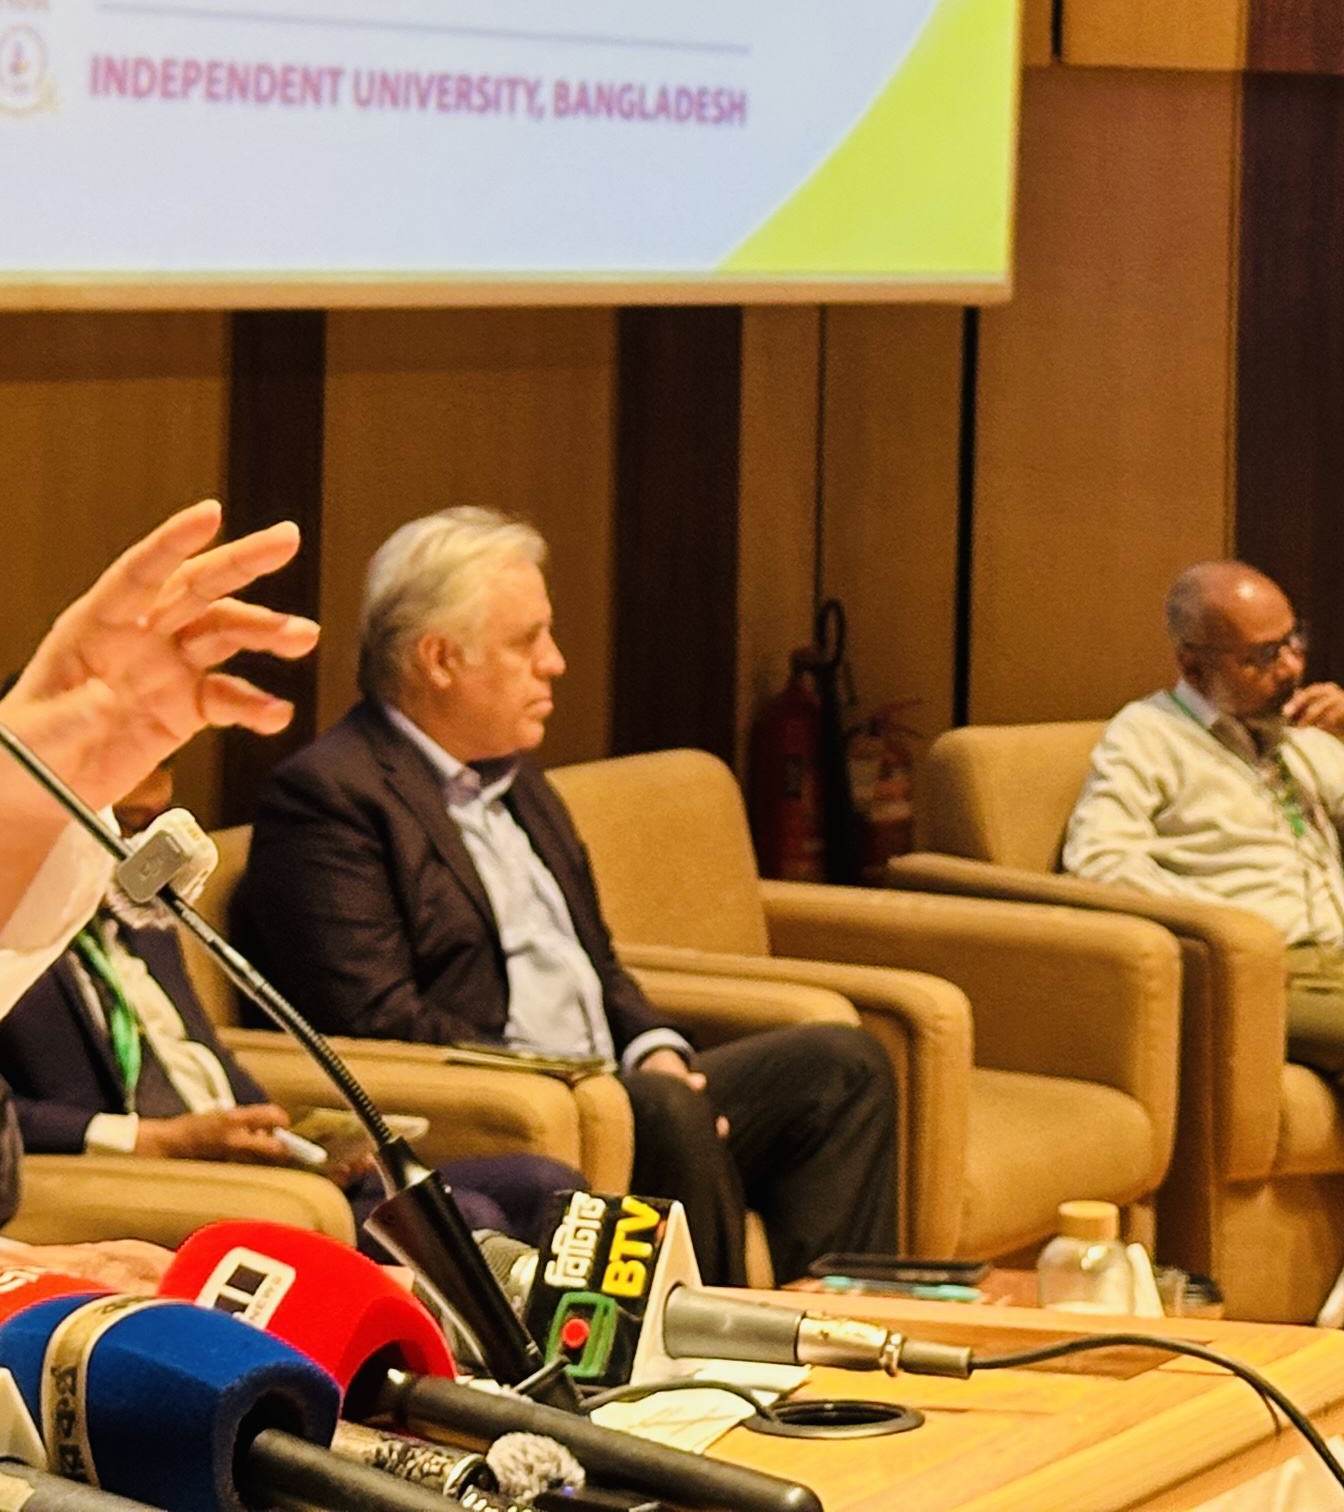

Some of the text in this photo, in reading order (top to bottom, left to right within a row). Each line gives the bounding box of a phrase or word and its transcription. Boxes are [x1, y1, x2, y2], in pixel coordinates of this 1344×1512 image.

[89, 53, 750, 126] INDEPENDENT UNIVERSITY, BANGLADESH
[602, 1195, 661, 1298] BTV
